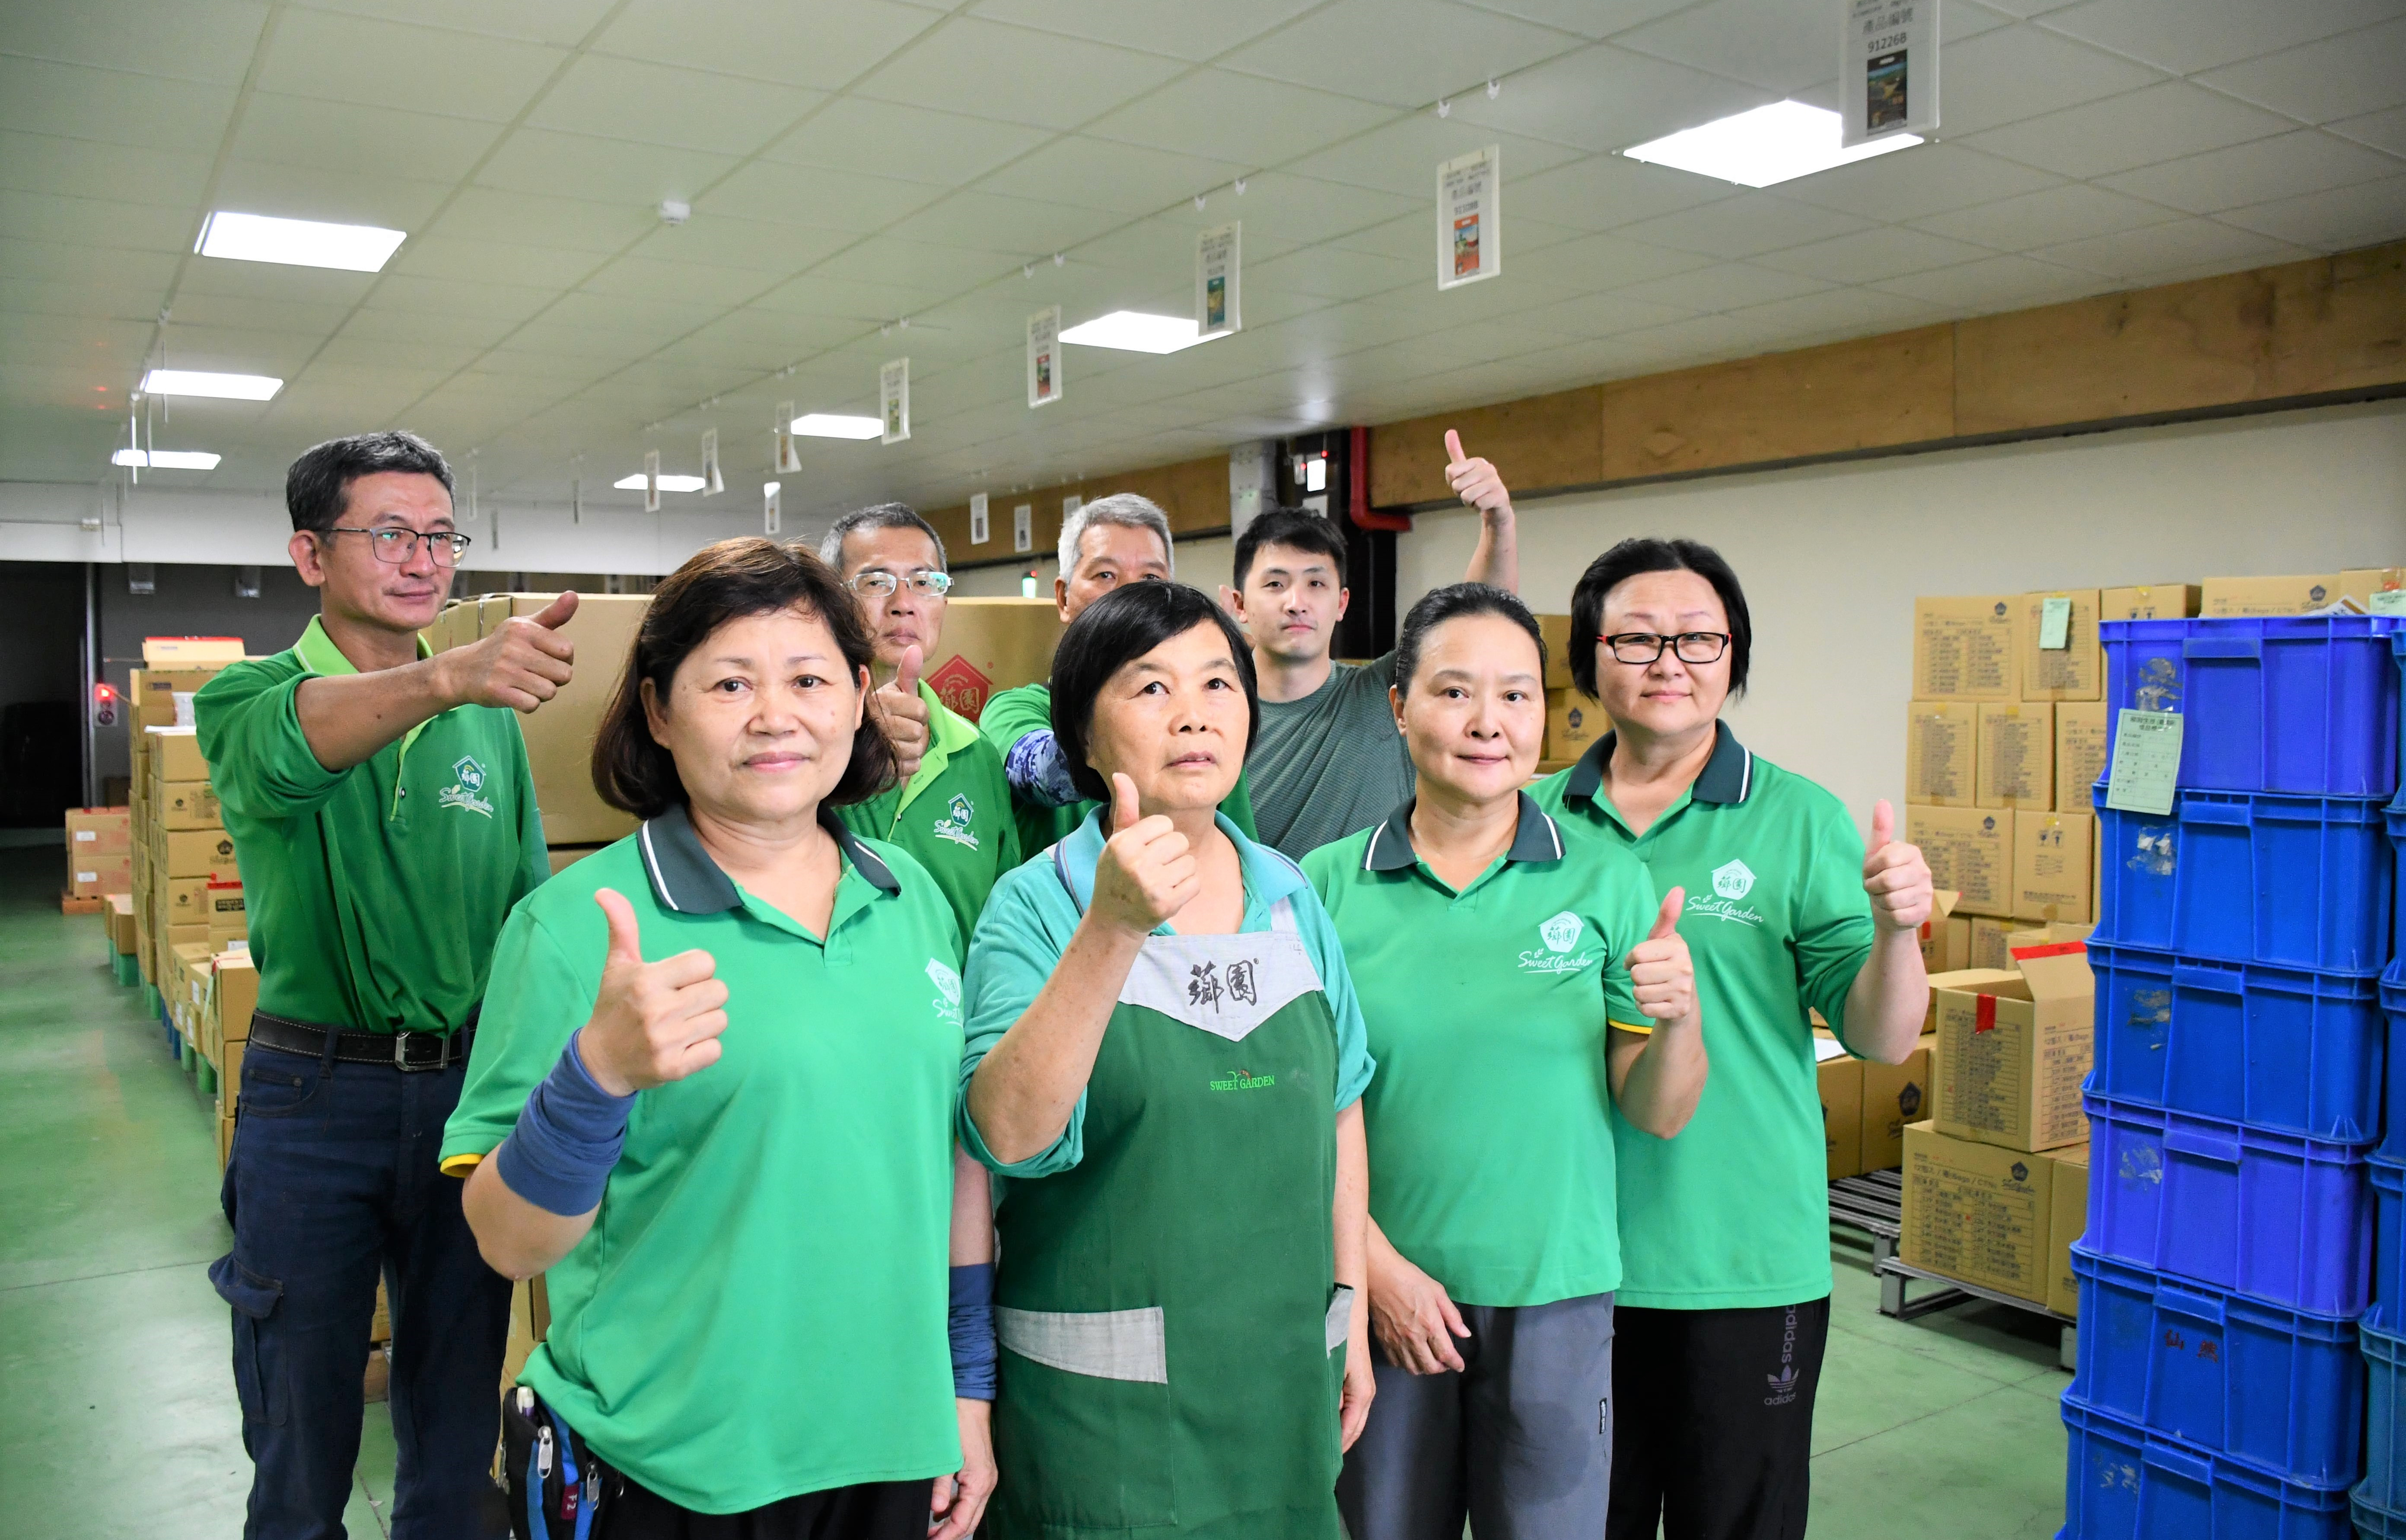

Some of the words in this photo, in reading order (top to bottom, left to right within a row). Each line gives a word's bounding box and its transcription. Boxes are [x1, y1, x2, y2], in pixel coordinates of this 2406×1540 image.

[1686, 896, 1725, 912] Sweet
[1721, 901, 1764, 923] Garden
[1517, 951, 1556, 968] Sweet
[1553, 951, 1593, 974] Garden
[1210, 1079, 1238, 1091] SWEET
[1239, 1075, 1275, 1089] GARDEN
[1763, 1391, 1796, 1405] adidas
